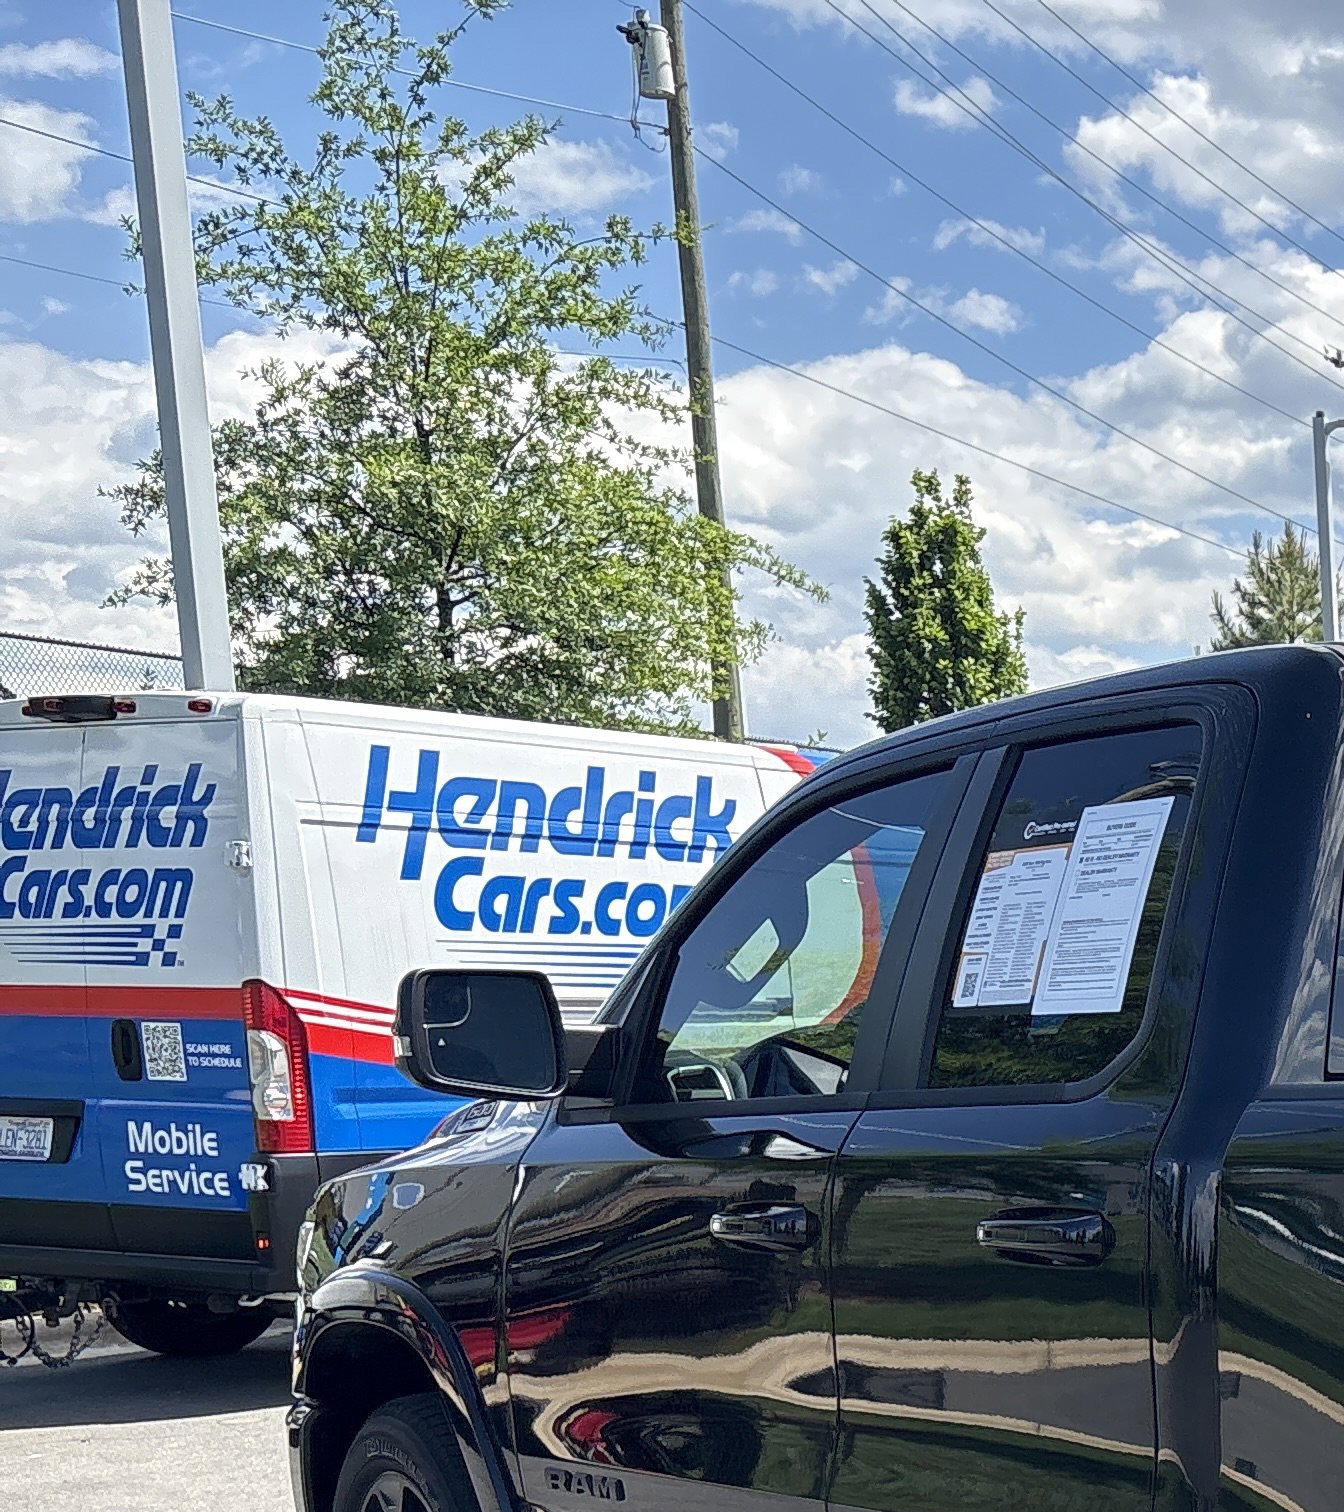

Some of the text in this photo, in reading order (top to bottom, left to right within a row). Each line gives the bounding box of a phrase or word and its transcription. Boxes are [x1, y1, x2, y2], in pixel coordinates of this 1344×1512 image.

[0, 763, 217, 850] endrick
[355, 744, 737, 881] Hendrick
[0, 855, 193, 919] Cars.com
[186, 1043, 232, 1055] SCAN HERE
[187, 1056, 243, 1068] TO SCHEDULE
[126, 1120, 219, 1158] Mobile
[124, 1159, 231, 1197] Service
[544, 1466, 628, 1503] RAM
